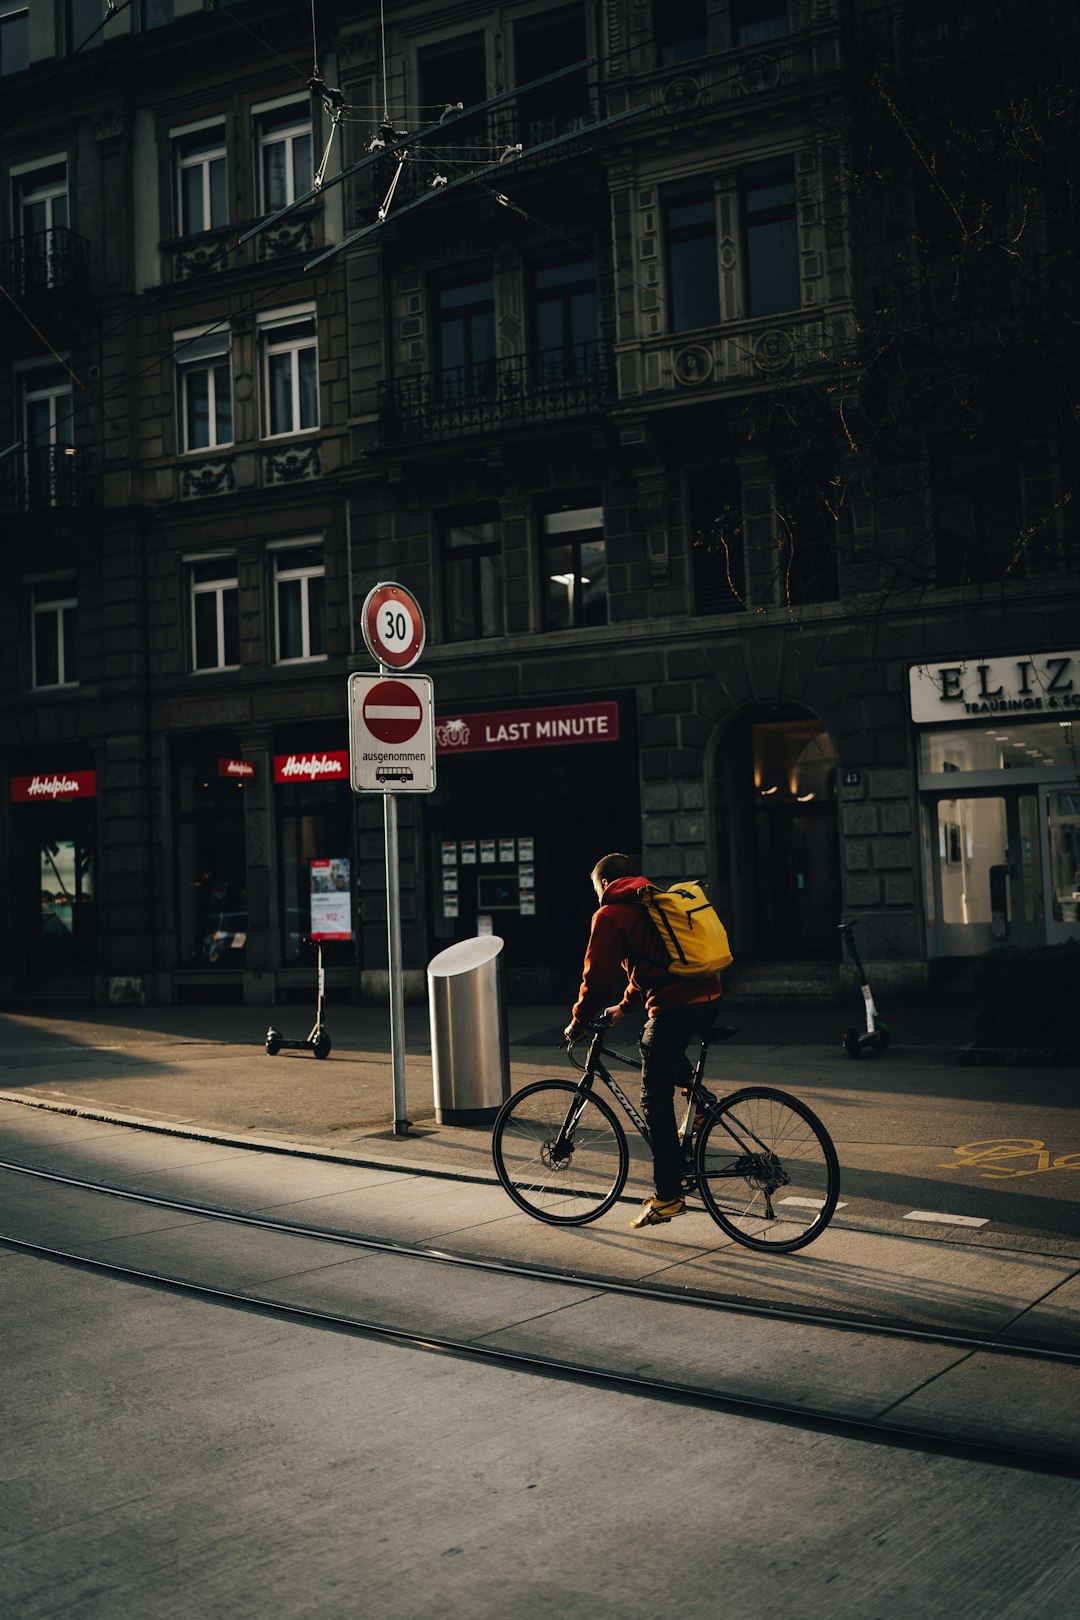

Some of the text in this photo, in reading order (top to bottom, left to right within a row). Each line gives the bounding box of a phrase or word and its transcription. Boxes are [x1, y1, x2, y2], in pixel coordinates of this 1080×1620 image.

[384, 611, 406, 640] 30
[938, 657, 1080, 701] ELIZ
[964, 697, 1042, 714] TRAURINGE
[1048, 695, 1058, 707] &
[435, 724, 471, 747] tur
[486, 715, 609, 743] LAST MINUTE
[281, 754, 342, 780] Hotelplan
[362, 752, 426, 763] ausgenommen
[27, 775, 80, 798] Hotelplan
